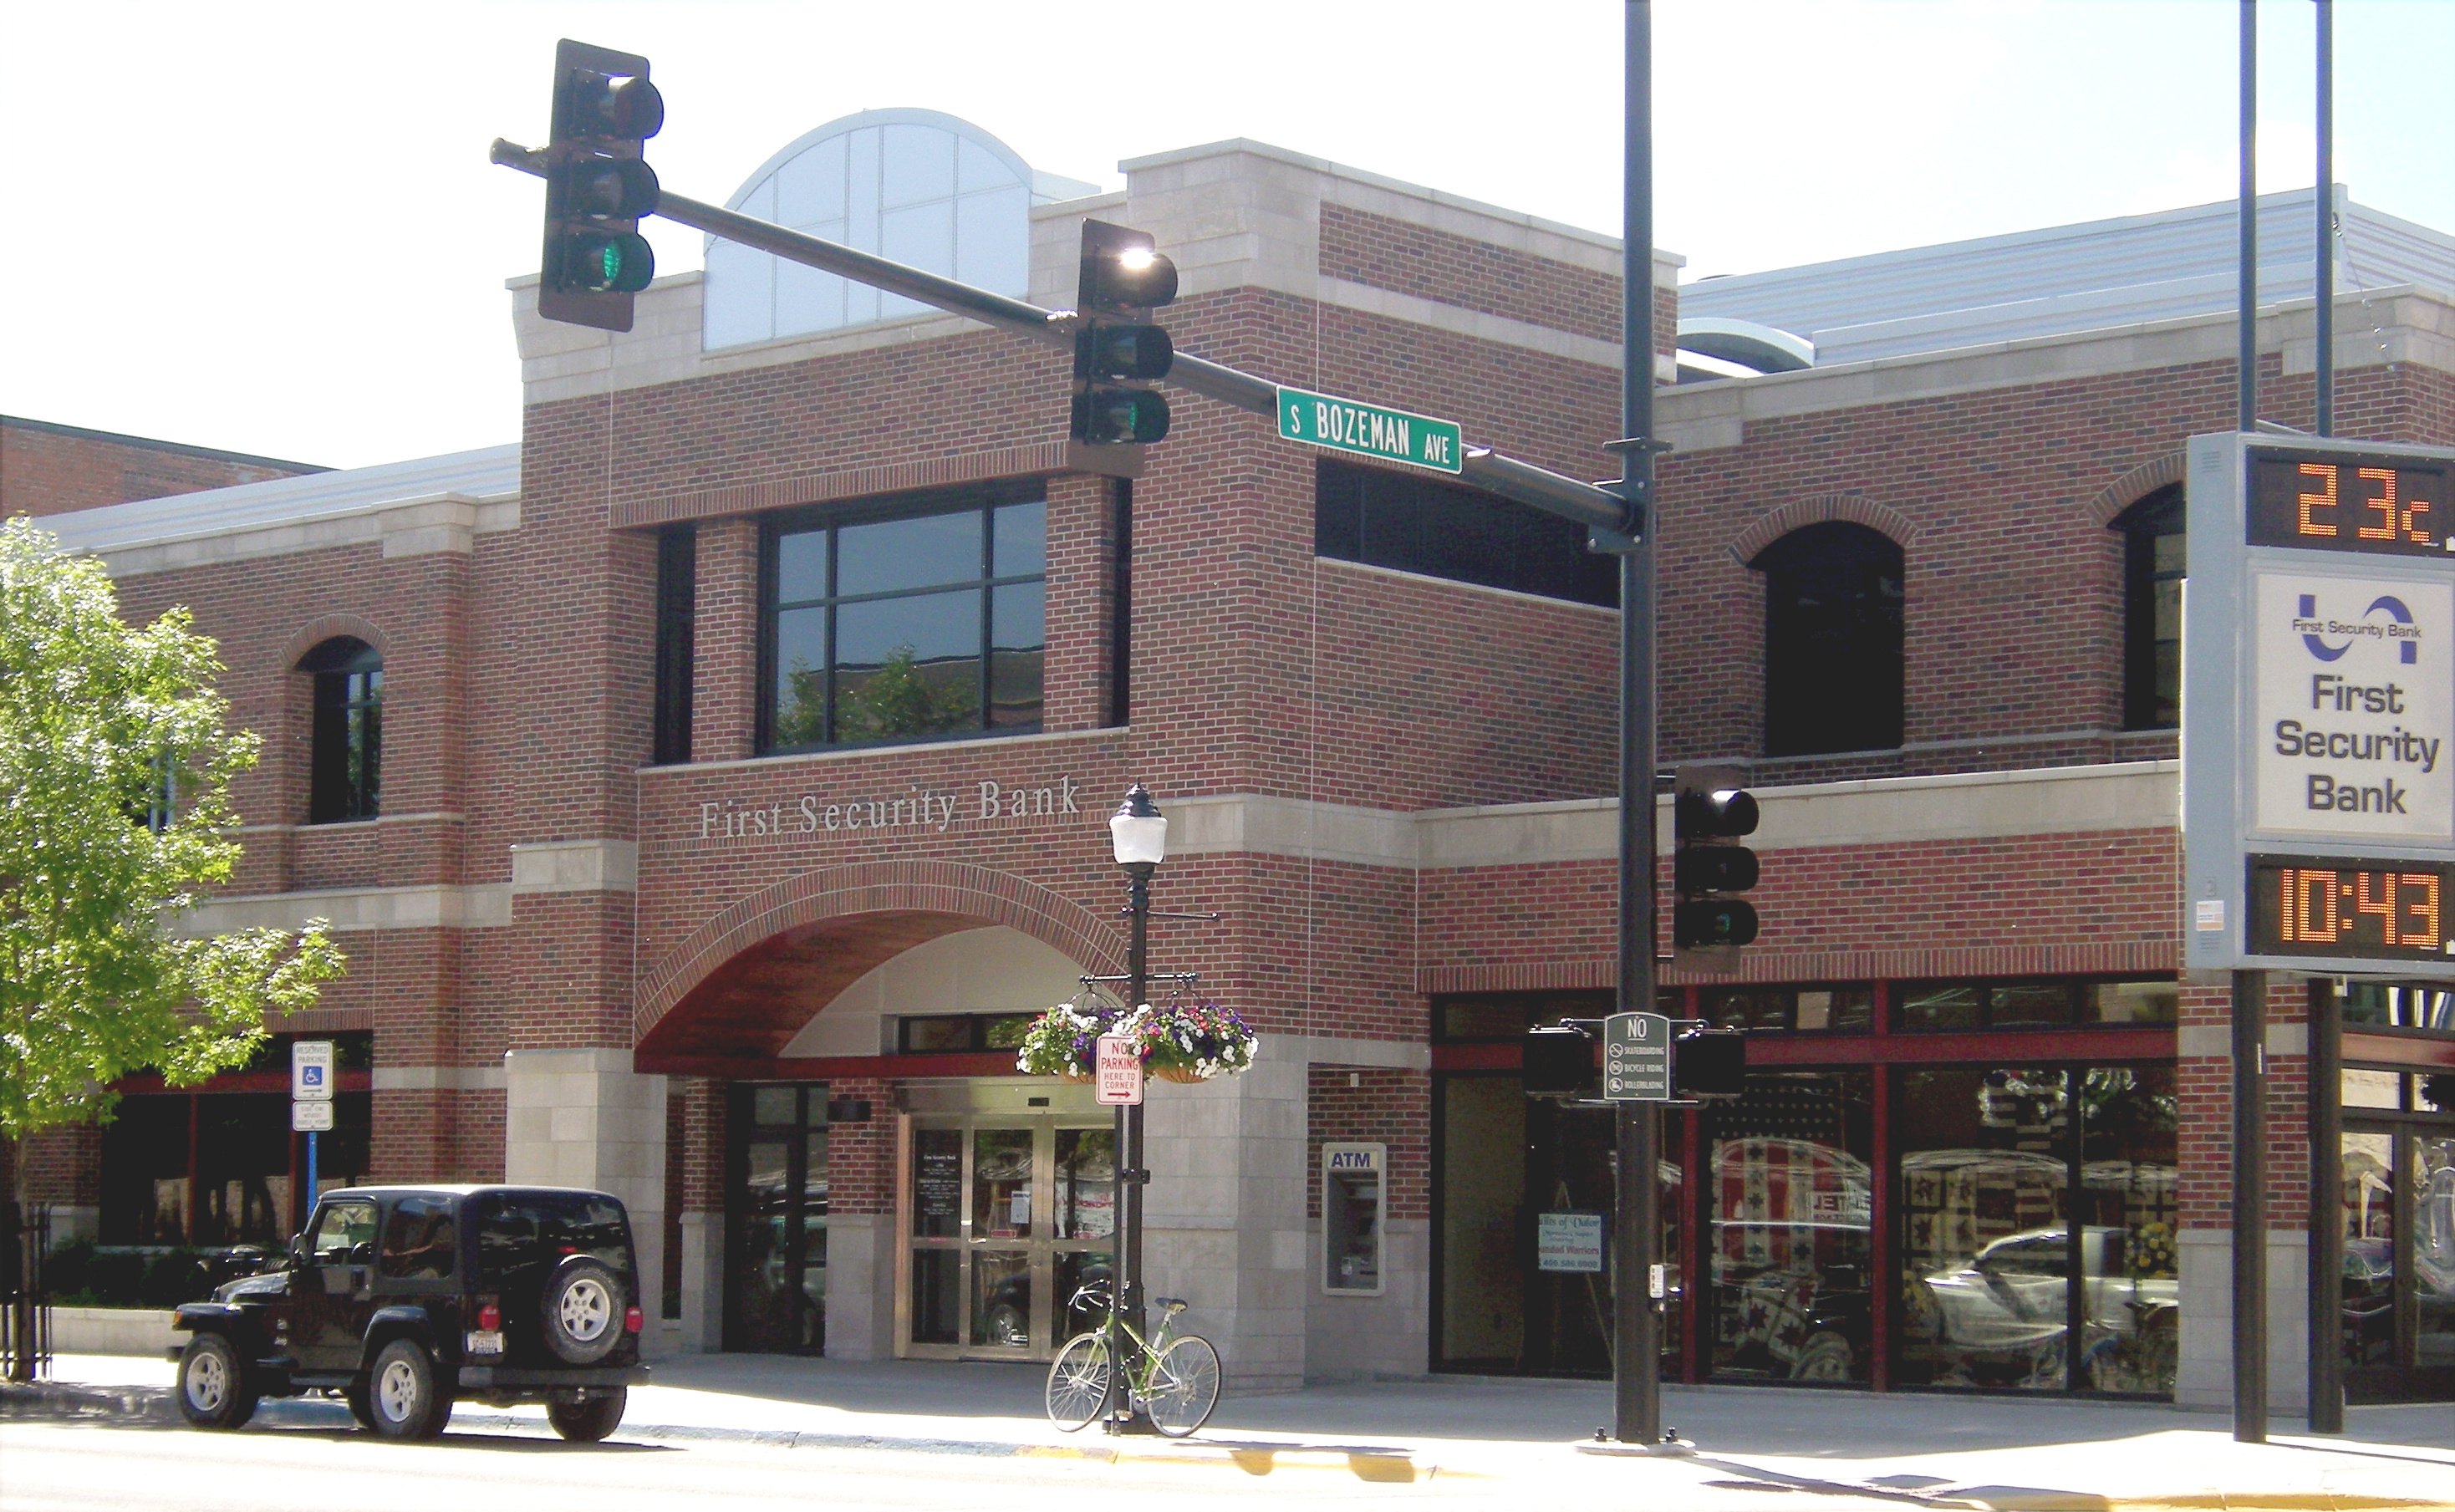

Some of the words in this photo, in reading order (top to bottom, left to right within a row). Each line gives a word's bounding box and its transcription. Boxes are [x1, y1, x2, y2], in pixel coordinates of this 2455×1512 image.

[1291, 405, 1301, 434] S
[1316, 401, 1410, 456] BOZEMAN
[1424, 433, 1450, 464] AVE
[2292, 619, 2324, 633] First
[2329, 620, 2384, 639] Security
[2388, 624, 2422, 638] Bank
[2311, 675, 2405, 715] First
[2275, 720, 2439, 773] Security
[700, 800, 782, 838] First
[799, 785, 956, 832] Security
[978, 775, 1080, 820] Bank
[2307, 775, 2407, 814] Bank
[2282, 868, 2439, 946] 10:43
[1627, 1019, 1647, 1038] NO
[1112, 1042, 1128, 1055] NO
[1101, 1057, 1138, 1070] PARKING
[1624, 1064, 1645, 1072] BICYCLE
[1647, 1064, 1664, 1073] RIDING
[1332, 1153, 1371, 1168] ATM
